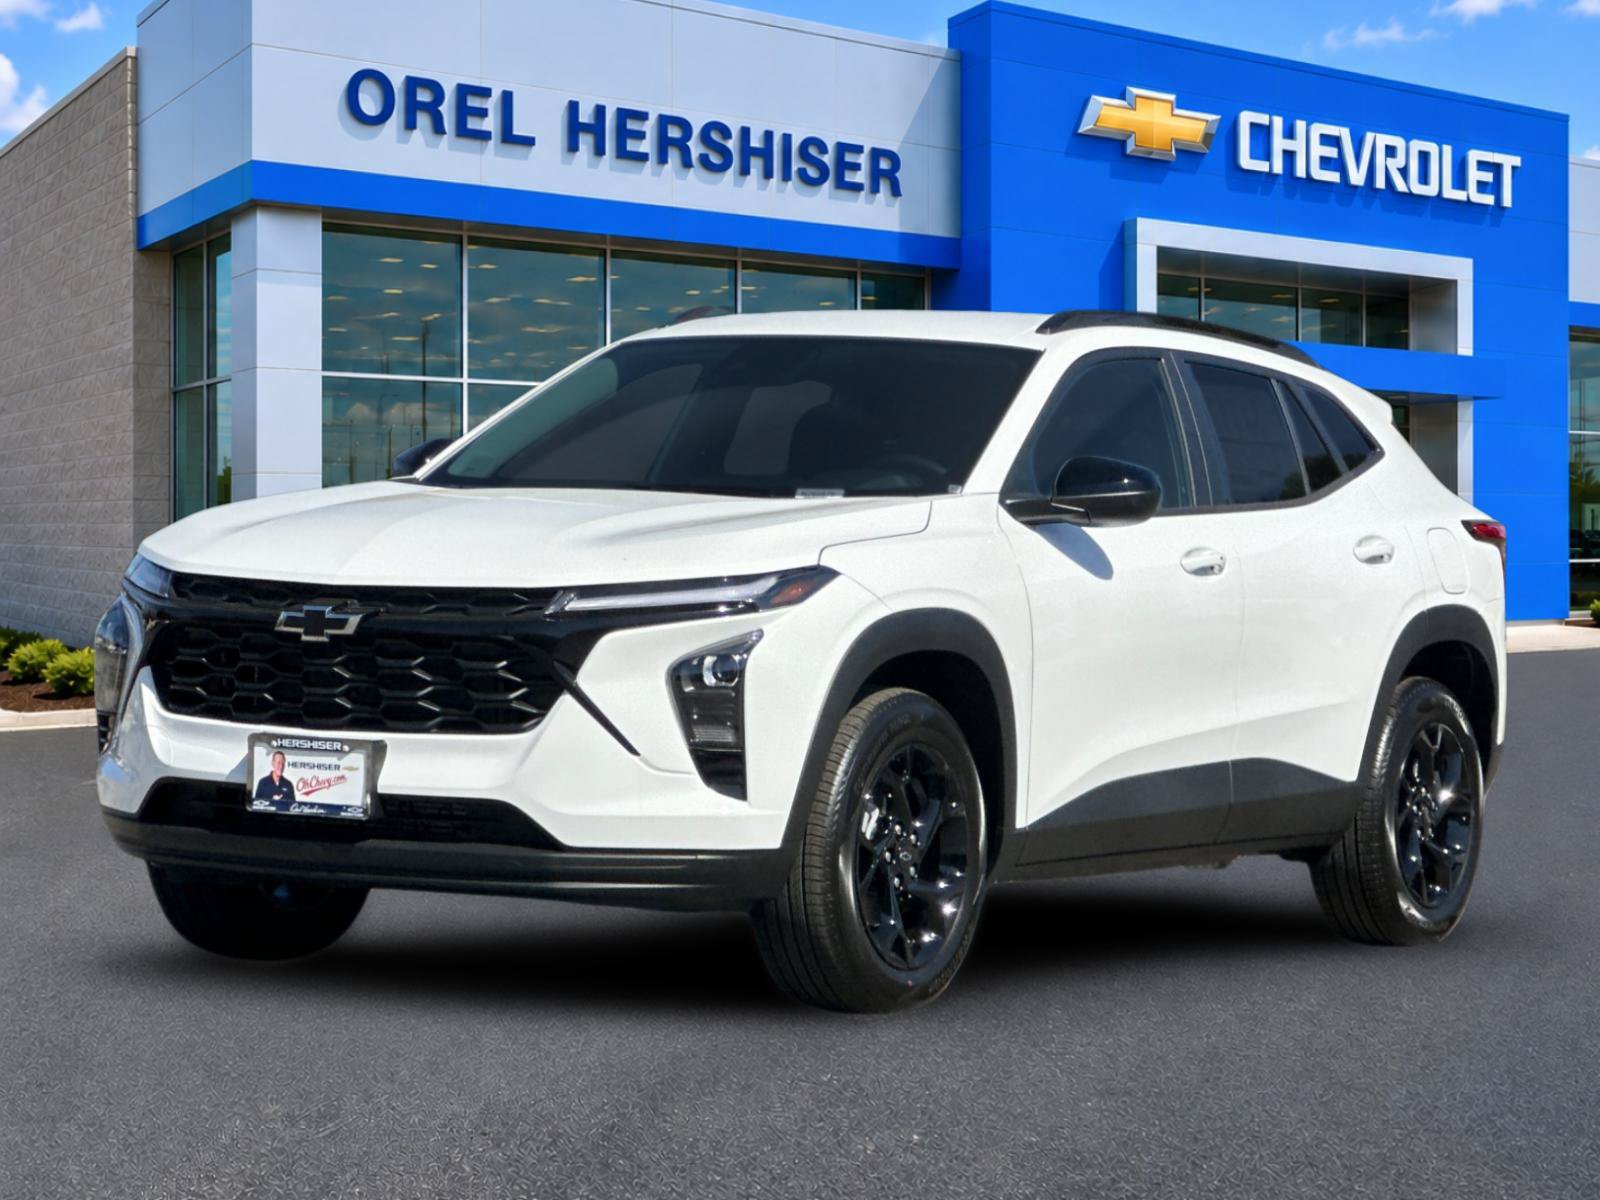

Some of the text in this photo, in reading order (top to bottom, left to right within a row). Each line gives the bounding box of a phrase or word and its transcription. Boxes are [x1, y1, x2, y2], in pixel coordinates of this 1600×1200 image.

[346, 68, 902, 198] OREL HERSHISER
[1237, 110, 1522, 208] CHEVROLET
[277, 738, 342, 751] HERSHISER
[288, 760, 341, 771] HERSHISER
